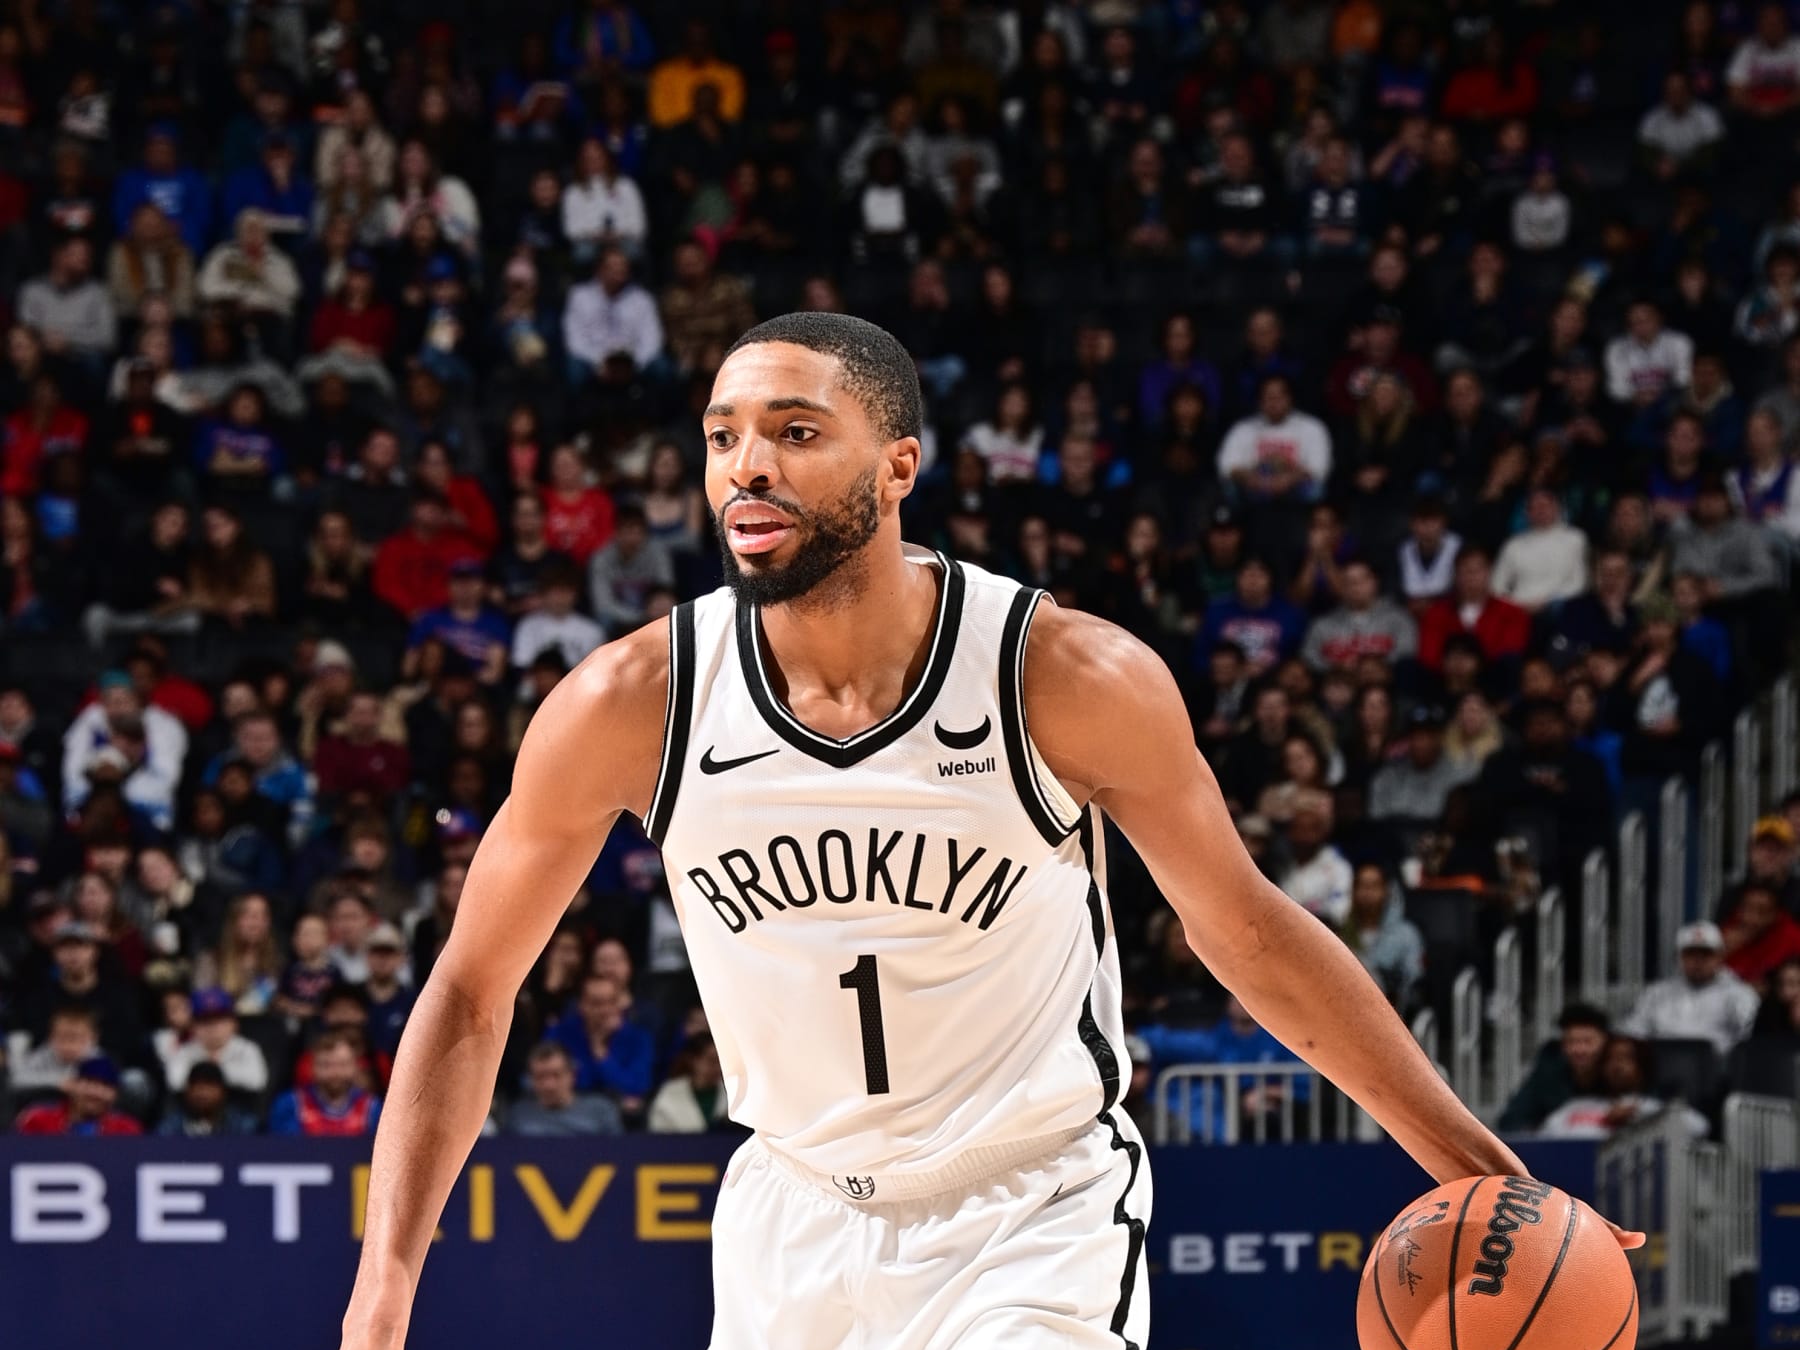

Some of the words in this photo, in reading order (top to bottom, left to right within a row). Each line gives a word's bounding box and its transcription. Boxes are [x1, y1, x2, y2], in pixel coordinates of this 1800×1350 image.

[937, 757, 996, 777] Webull
[687, 828, 1028, 934] BROOKLYN
[839, 954, 890, 1096] 1
[1168, 1231, 1378, 1274] BETR
